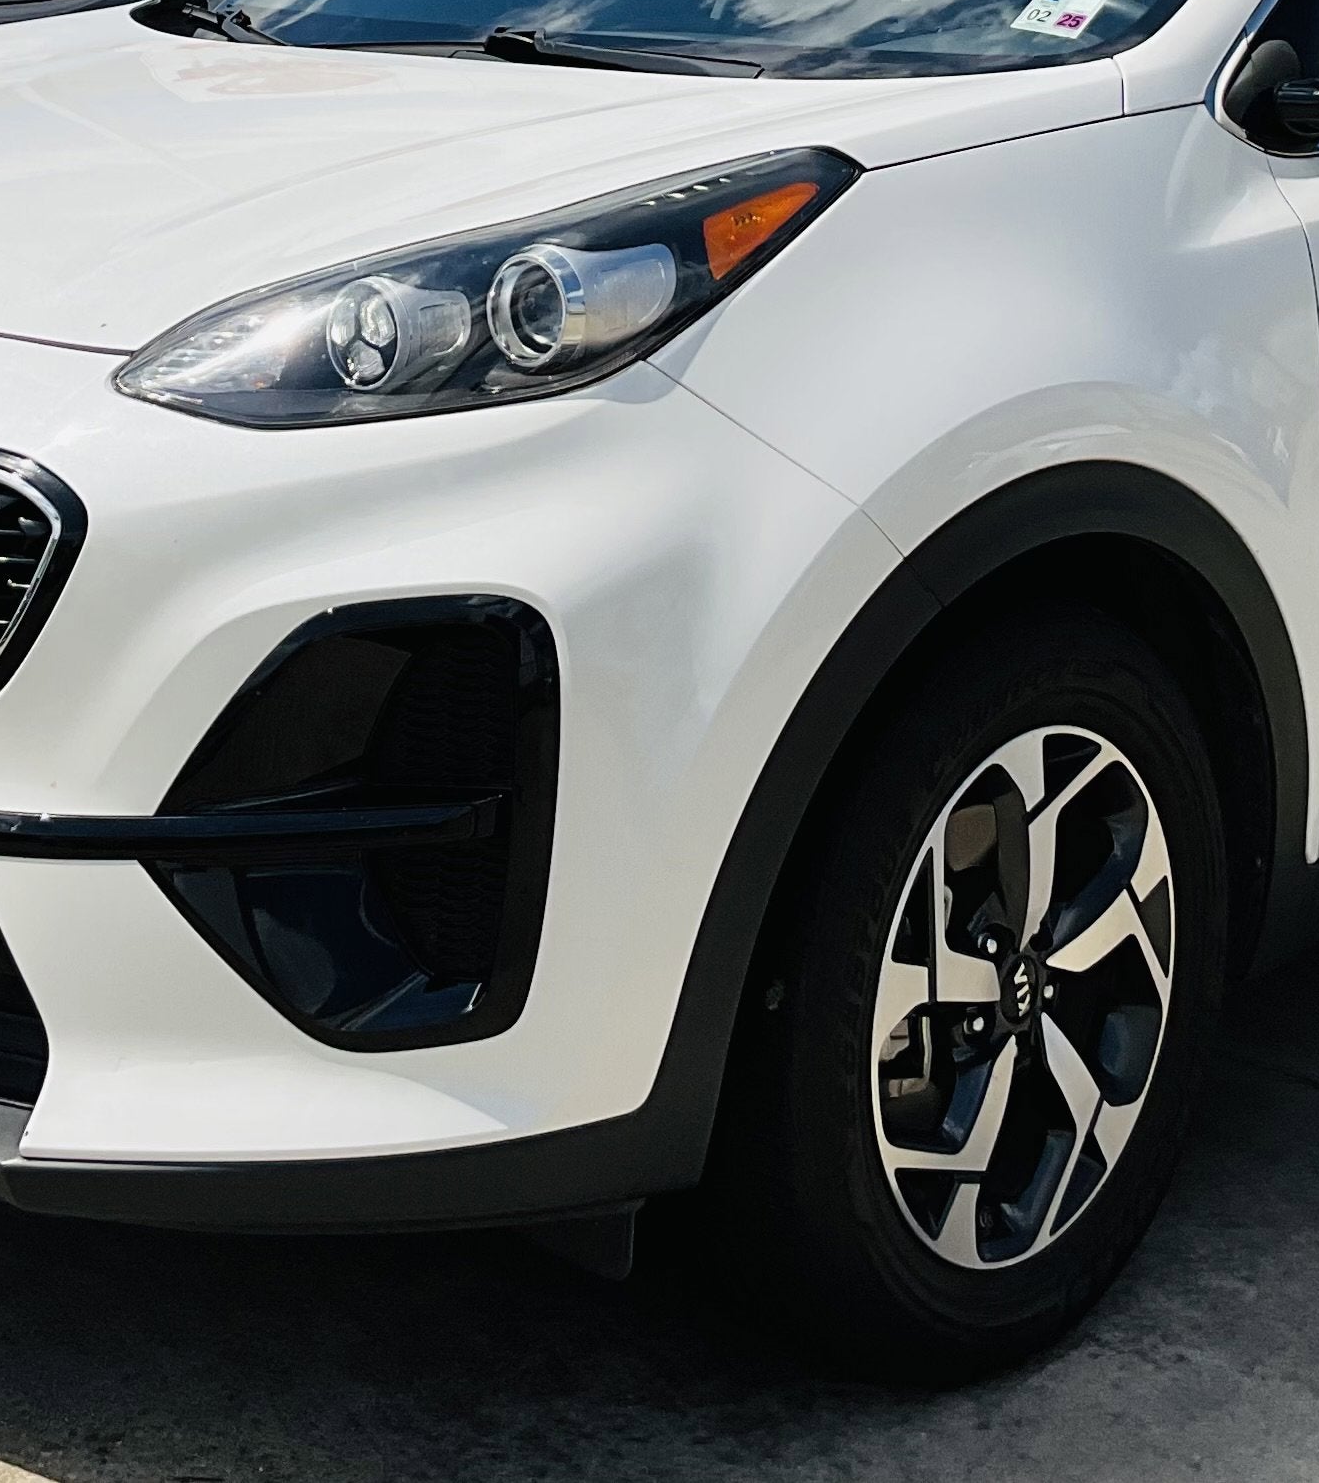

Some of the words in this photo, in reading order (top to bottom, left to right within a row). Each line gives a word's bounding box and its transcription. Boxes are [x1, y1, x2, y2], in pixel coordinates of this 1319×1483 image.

[1027, 9, 1052, 22] 02
[1056, 13, 1083, 28] 25
[1013, 962, 1031, 1017] KIA
